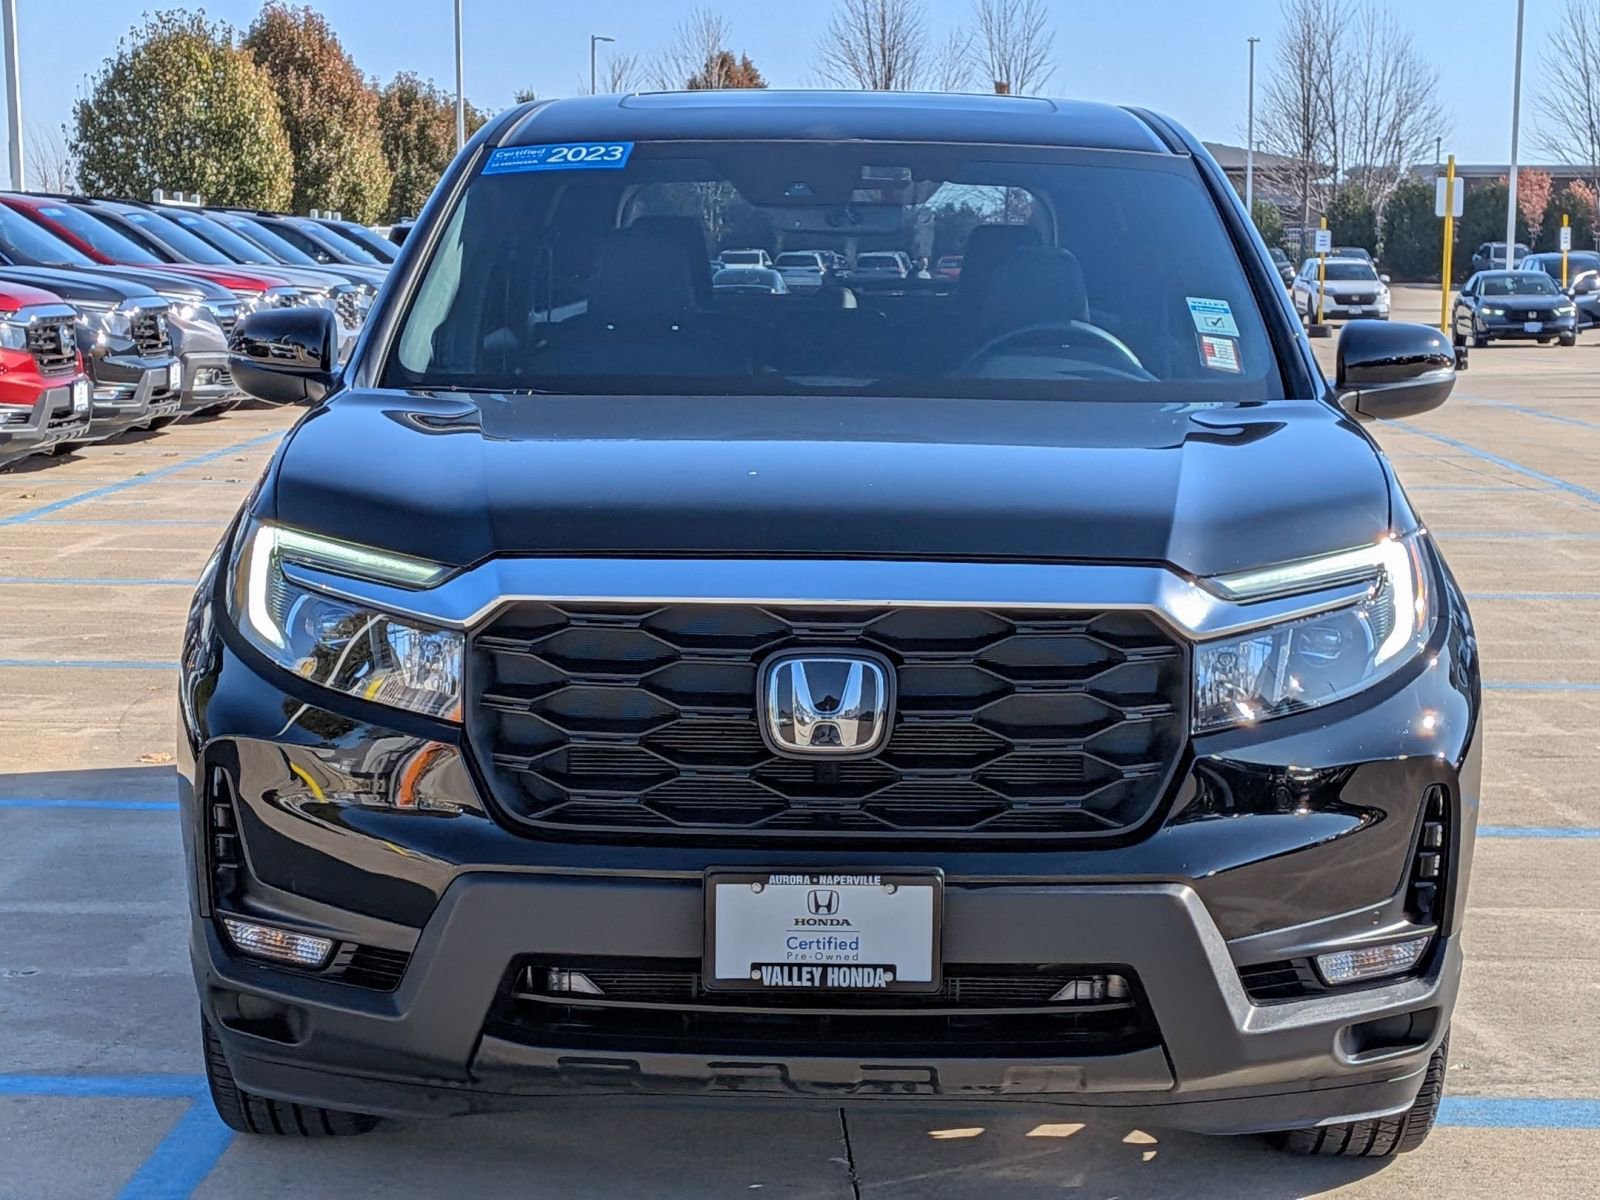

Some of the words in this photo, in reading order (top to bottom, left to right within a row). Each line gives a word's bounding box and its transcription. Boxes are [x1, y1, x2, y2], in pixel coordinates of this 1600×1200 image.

[496, 148, 546, 158] Certified
[546, 146, 623, 163] 2023
[769, 875, 810, 885] AURORA
[819, 876, 881, 885] NAPERVILLE
[794, 918, 852, 926] HONDA
[787, 936, 859, 951] Certified
[787, 952, 859, 961] Pre-Owned
[761, 966, 824, 986] VALLEY
[827, 967, 887, 988] HONDA
